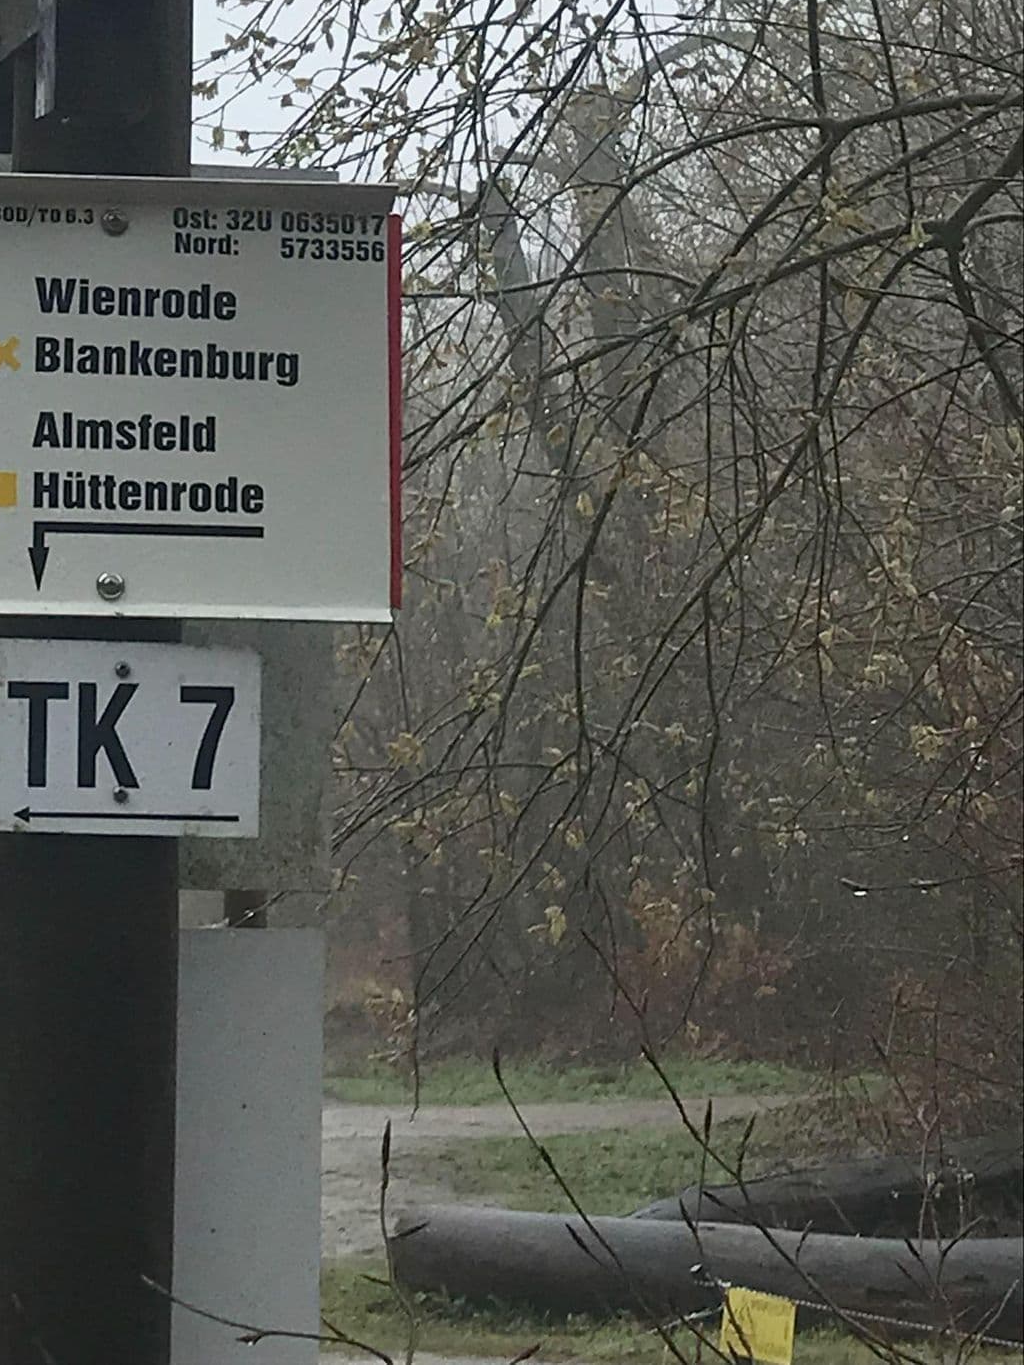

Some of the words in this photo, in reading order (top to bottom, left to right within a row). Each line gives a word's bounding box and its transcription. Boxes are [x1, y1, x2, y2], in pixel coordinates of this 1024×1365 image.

[173, 207, 218, 230] Ost:
[226, 209, 272, 232] 32U
[280, 211, 385, 236] 0635017
[174, 232, 239, 255] Nord:
[280, 237, 385, 263] 5733556
[35, 276, 237, 321] Wienrode
[35, 336, 299, 387] Blankenburg
[32, 411, 216, 453] Almsfeld
[32, 471, 264, 514] Hüttenrode
[7, 681, 140, 789] TK
[179, 685, 235, 791] 7
